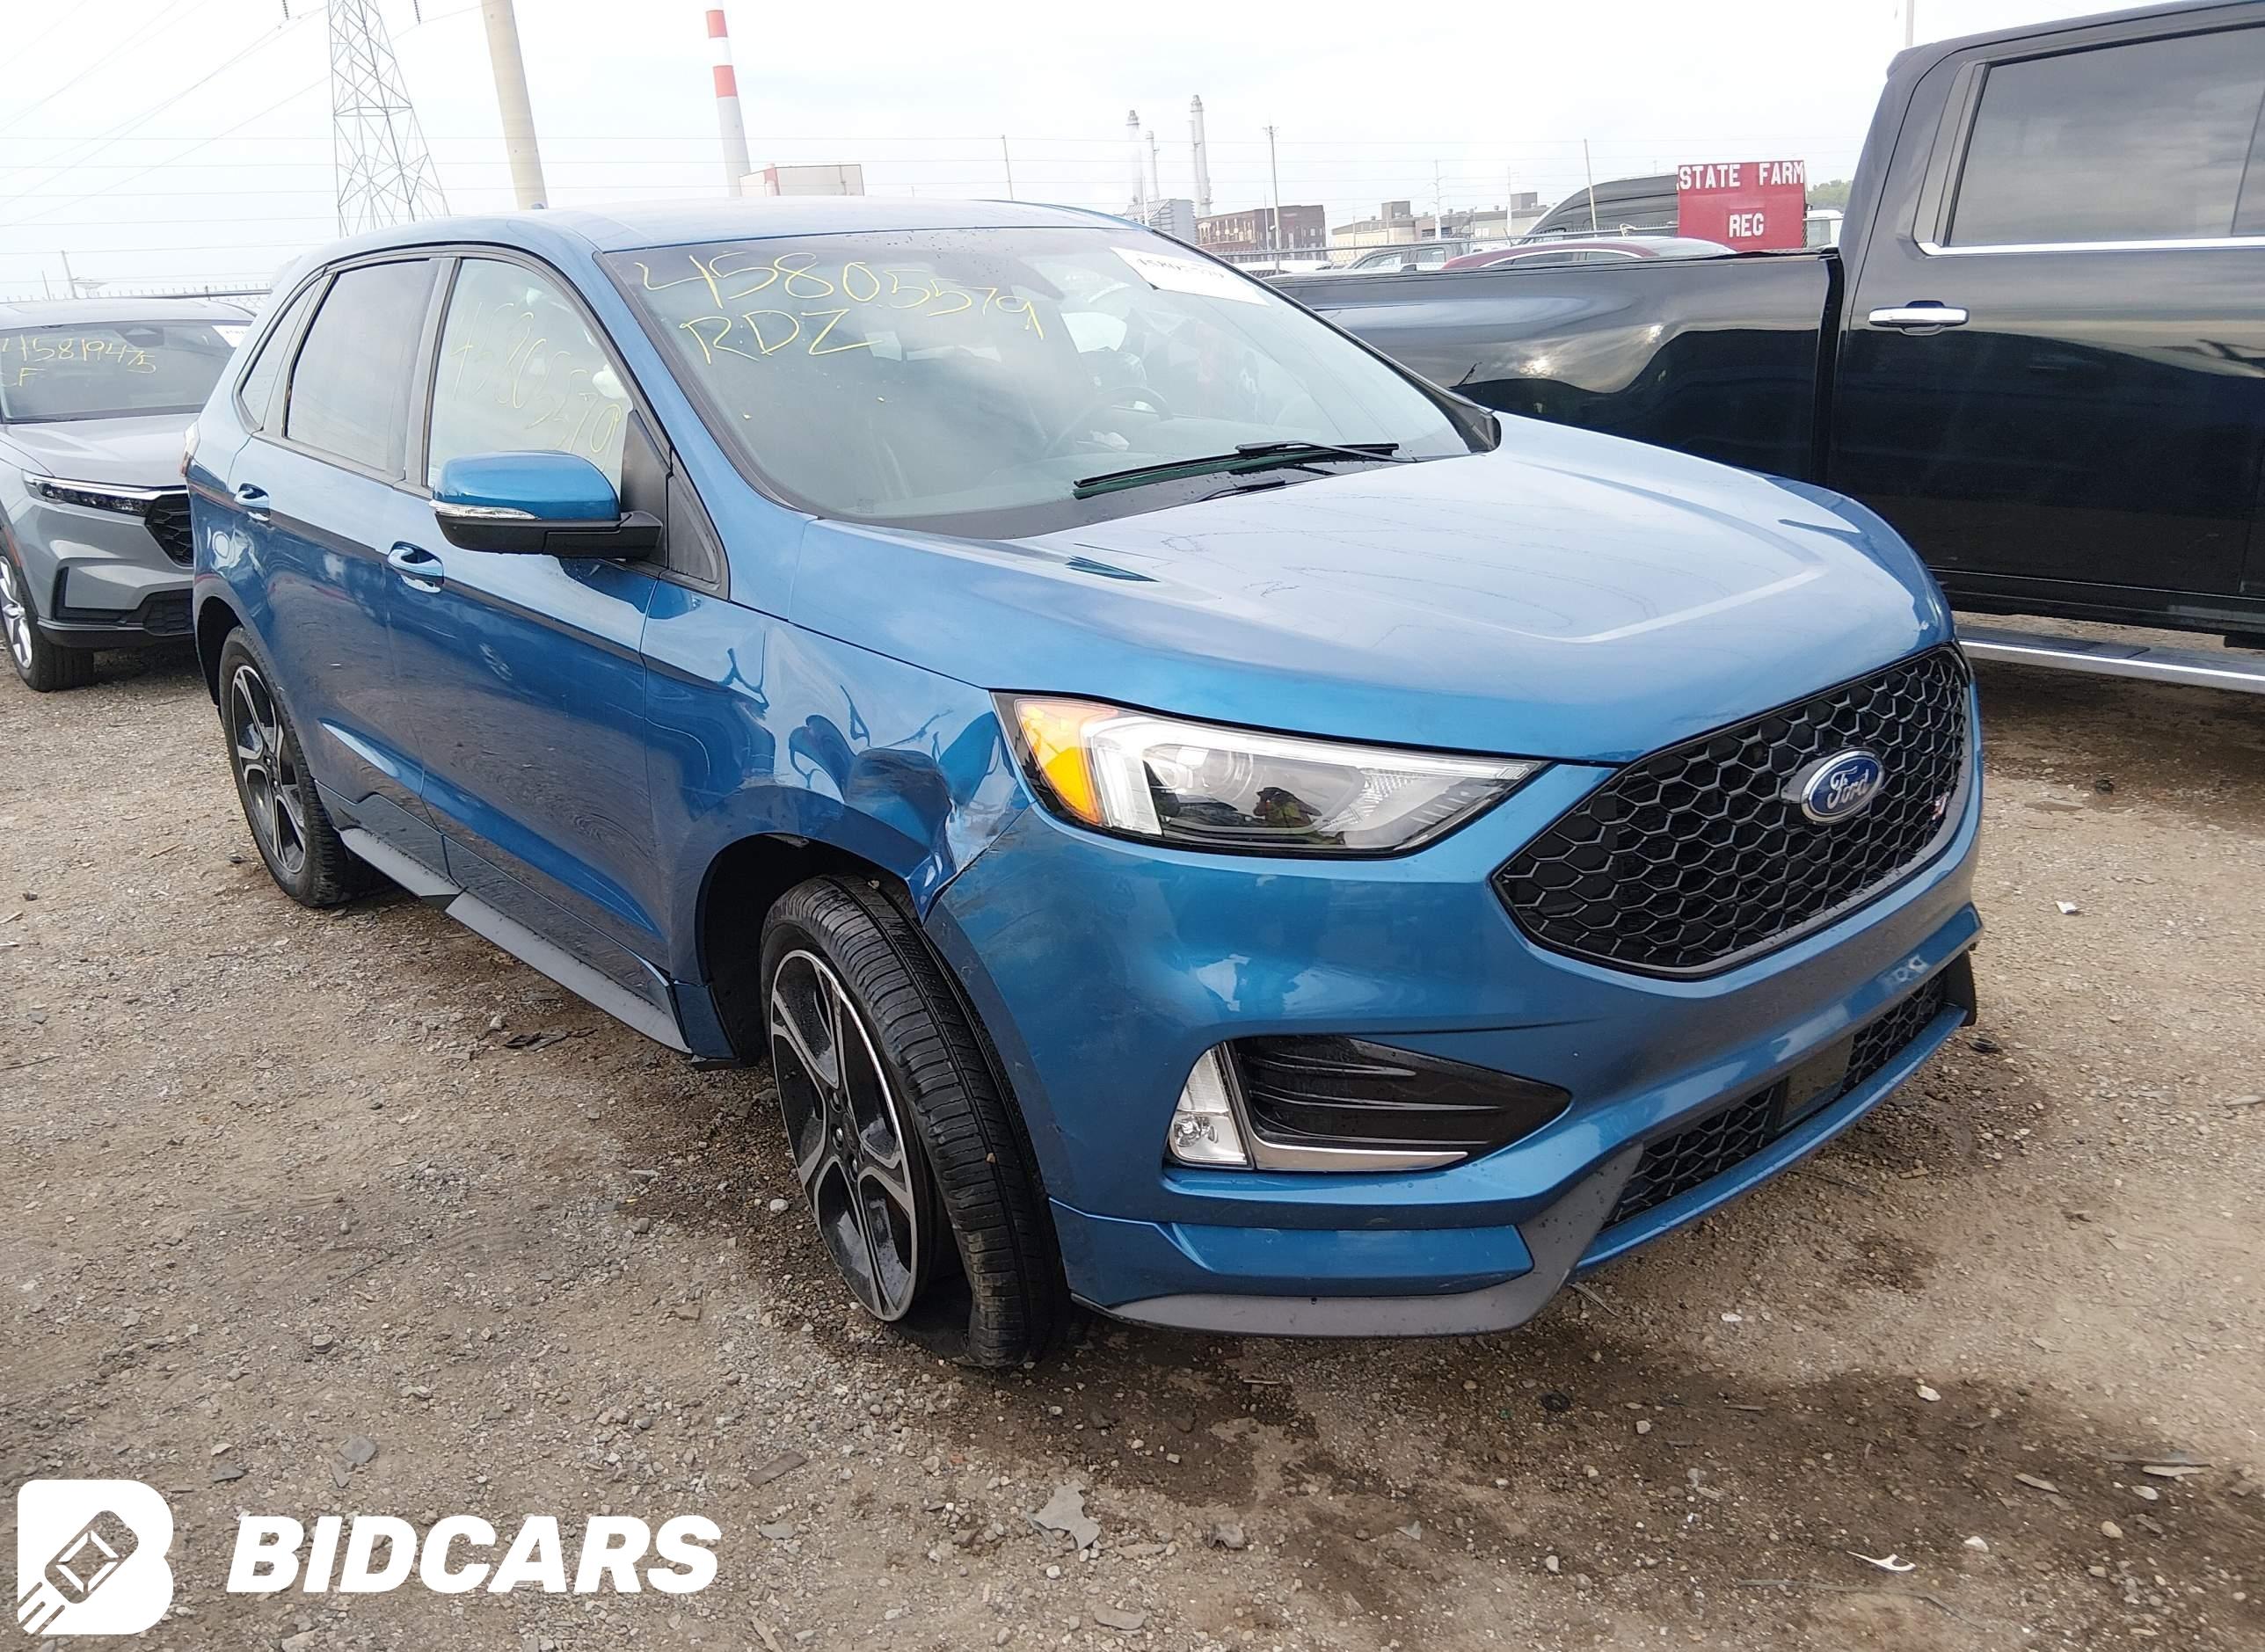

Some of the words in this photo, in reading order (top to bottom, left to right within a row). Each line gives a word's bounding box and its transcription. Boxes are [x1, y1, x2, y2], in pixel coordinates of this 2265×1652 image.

[1679, 164, 1741, 190] STATE
[1759, 162, 1803, 186] FARM
[1729, 213, 1764, 238] REG
[634, 252, 1044, 339] 45805579
[680, 309, 883, 364] RDZ
[1827, 766, 1869, 809] Ford
